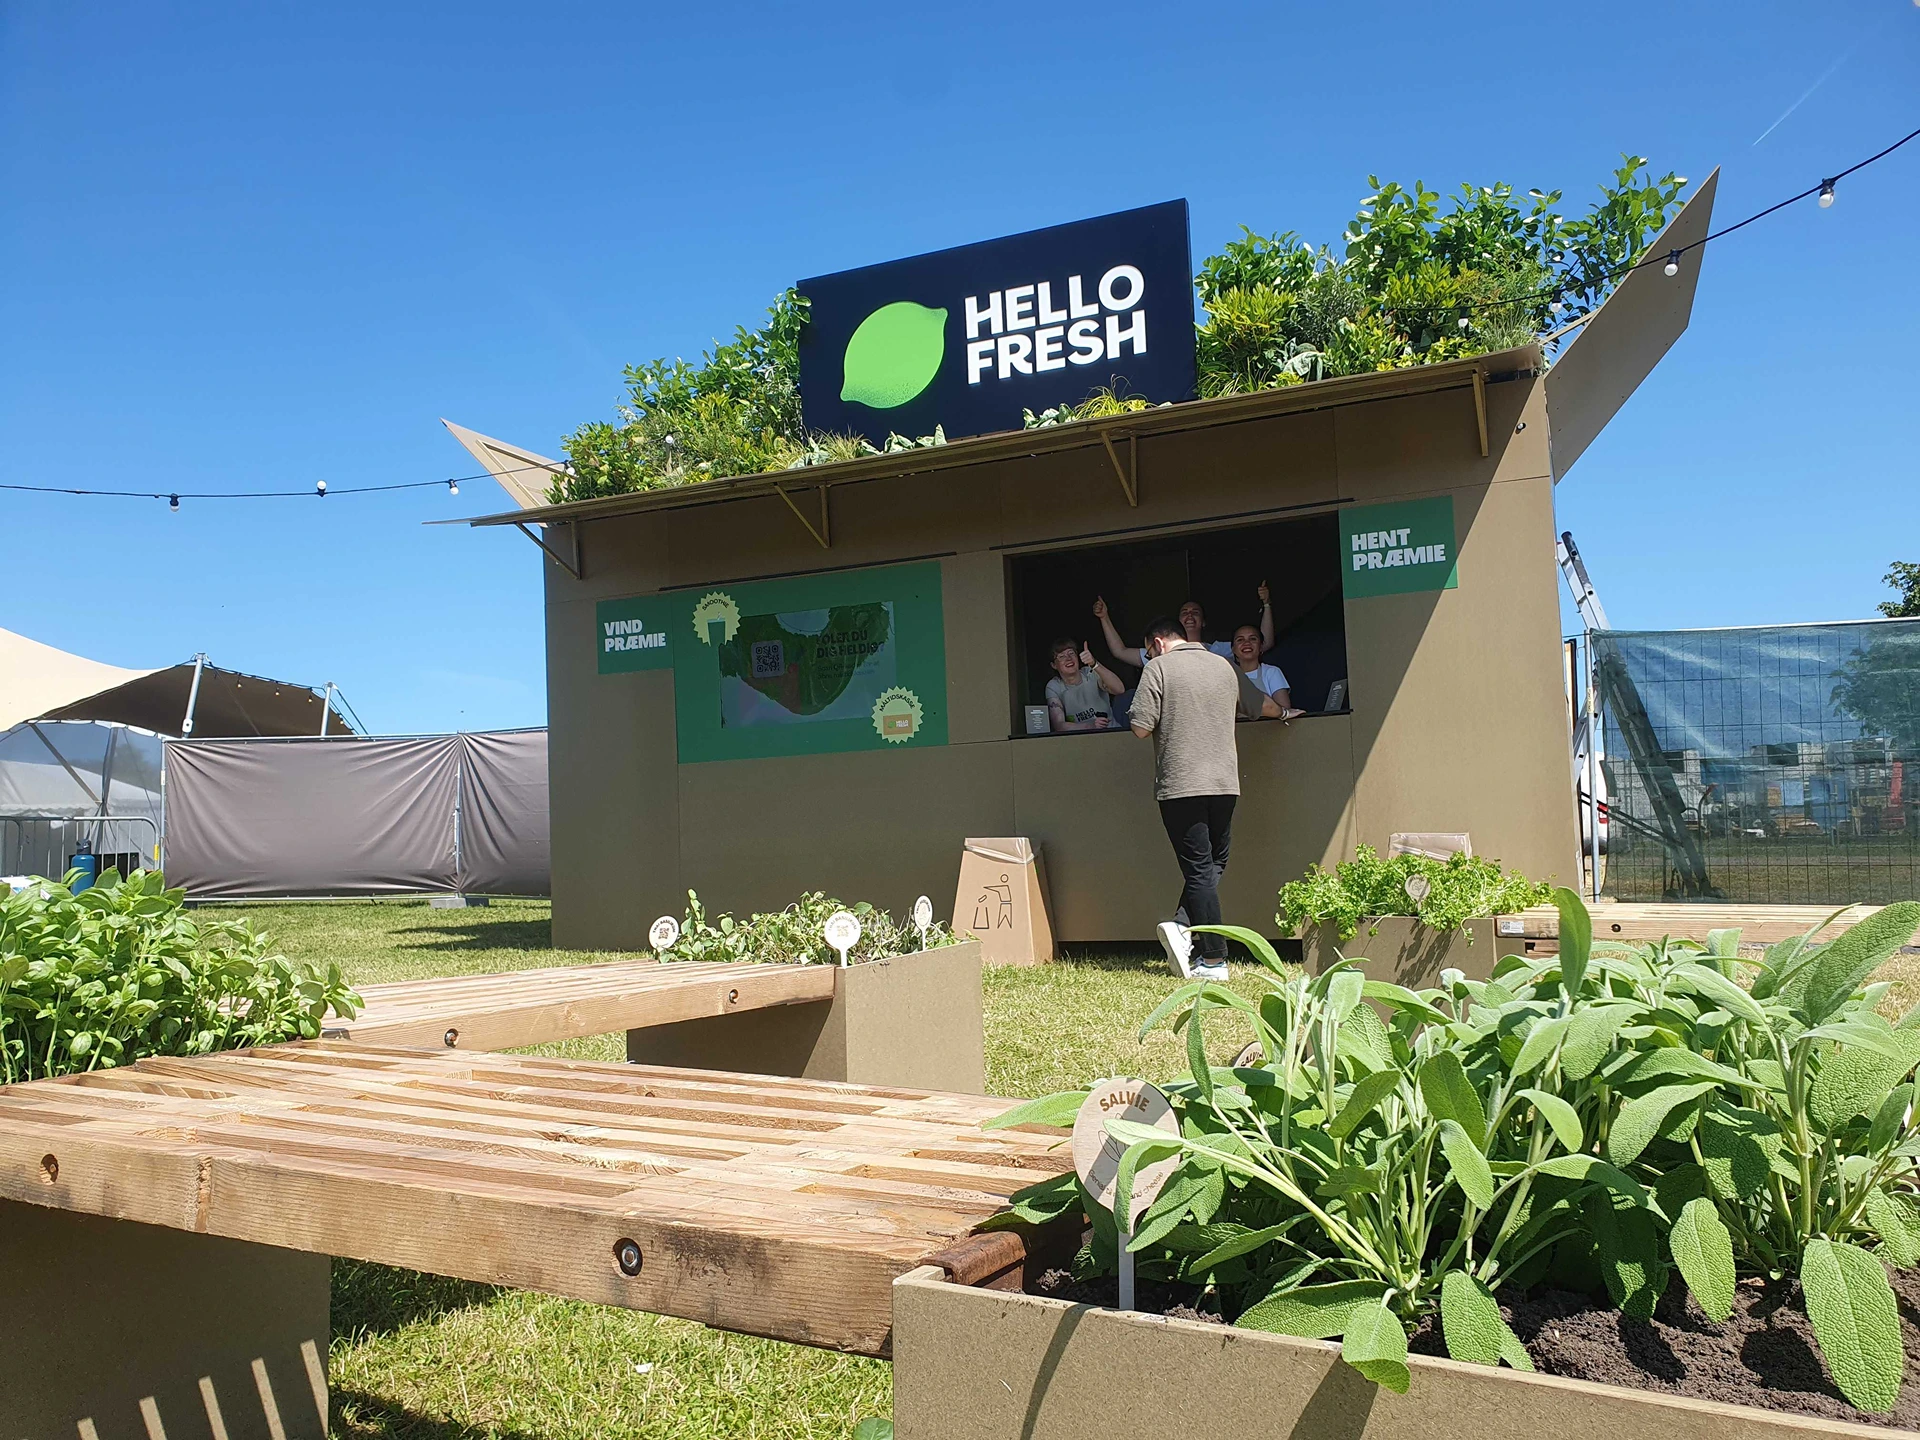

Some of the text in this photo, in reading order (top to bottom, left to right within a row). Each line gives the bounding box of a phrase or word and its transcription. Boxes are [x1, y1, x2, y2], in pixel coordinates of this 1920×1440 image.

[965, 264, 1145, 339] HELLO
[967, 309, 1147, 384] FRESH
[1351, 528, 1411, 552] HENT
[1352, 544, 1446, 571] PRÆMIE
[702, 599, 730, 611] SMOOTHIE
[604, 619, 643, 636] VIND
[604, 632, 667, 652] PRÆMIE
[1075, 707, 1095, 718] HELLO
[1099, 1090, 1150, 1112] SALVIE
